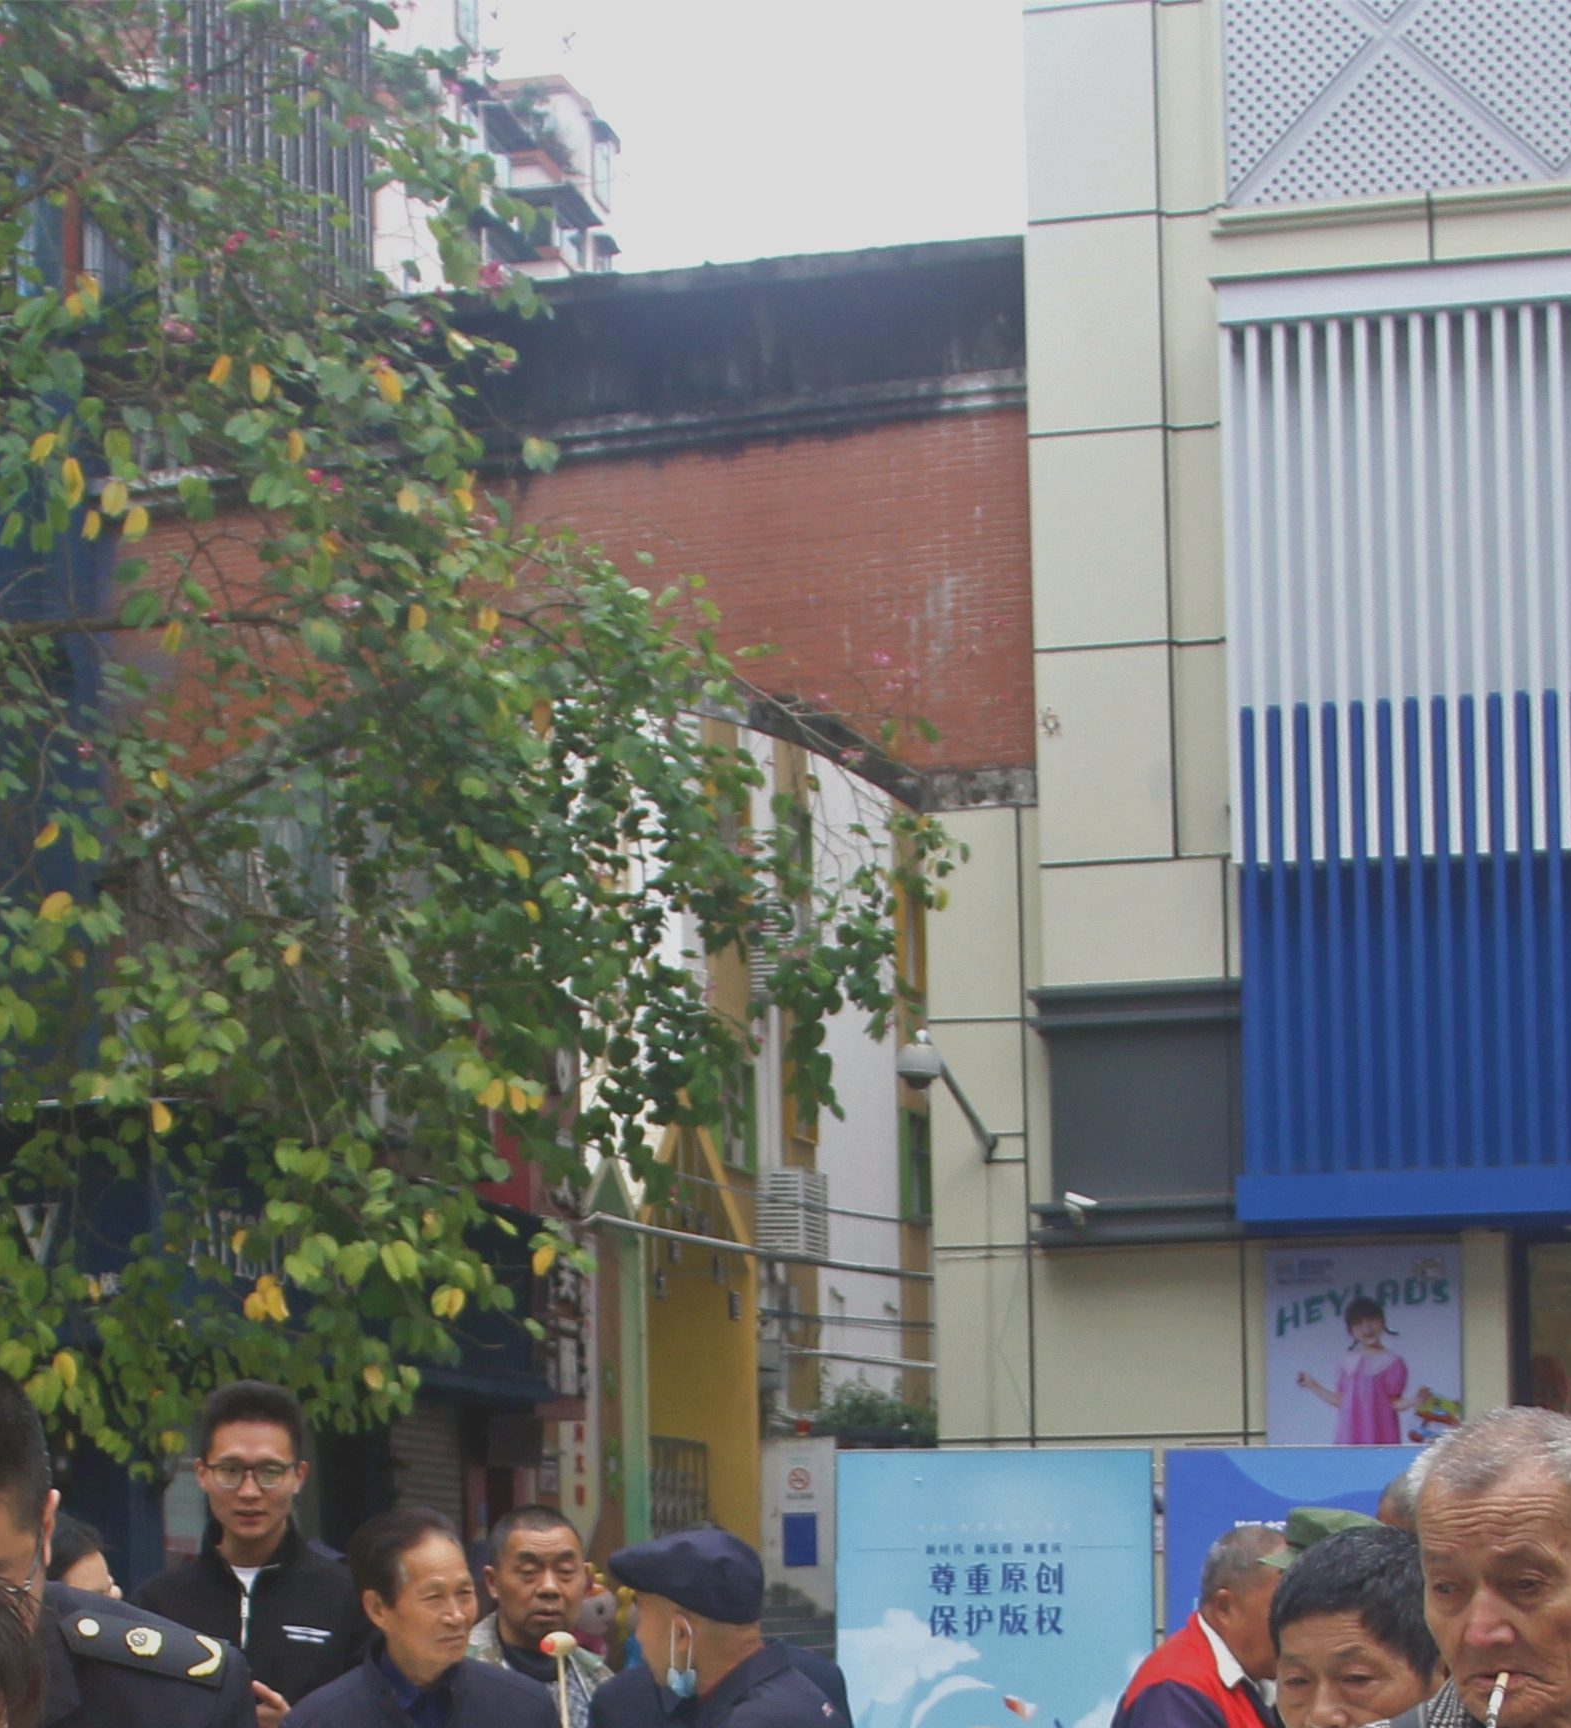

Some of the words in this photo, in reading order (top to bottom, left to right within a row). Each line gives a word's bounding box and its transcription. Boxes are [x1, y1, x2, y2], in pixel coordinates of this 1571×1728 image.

[929, 1561, 1065, 1596] 尊重原创
[929, 1603, 1065, 1637] 保护版权
